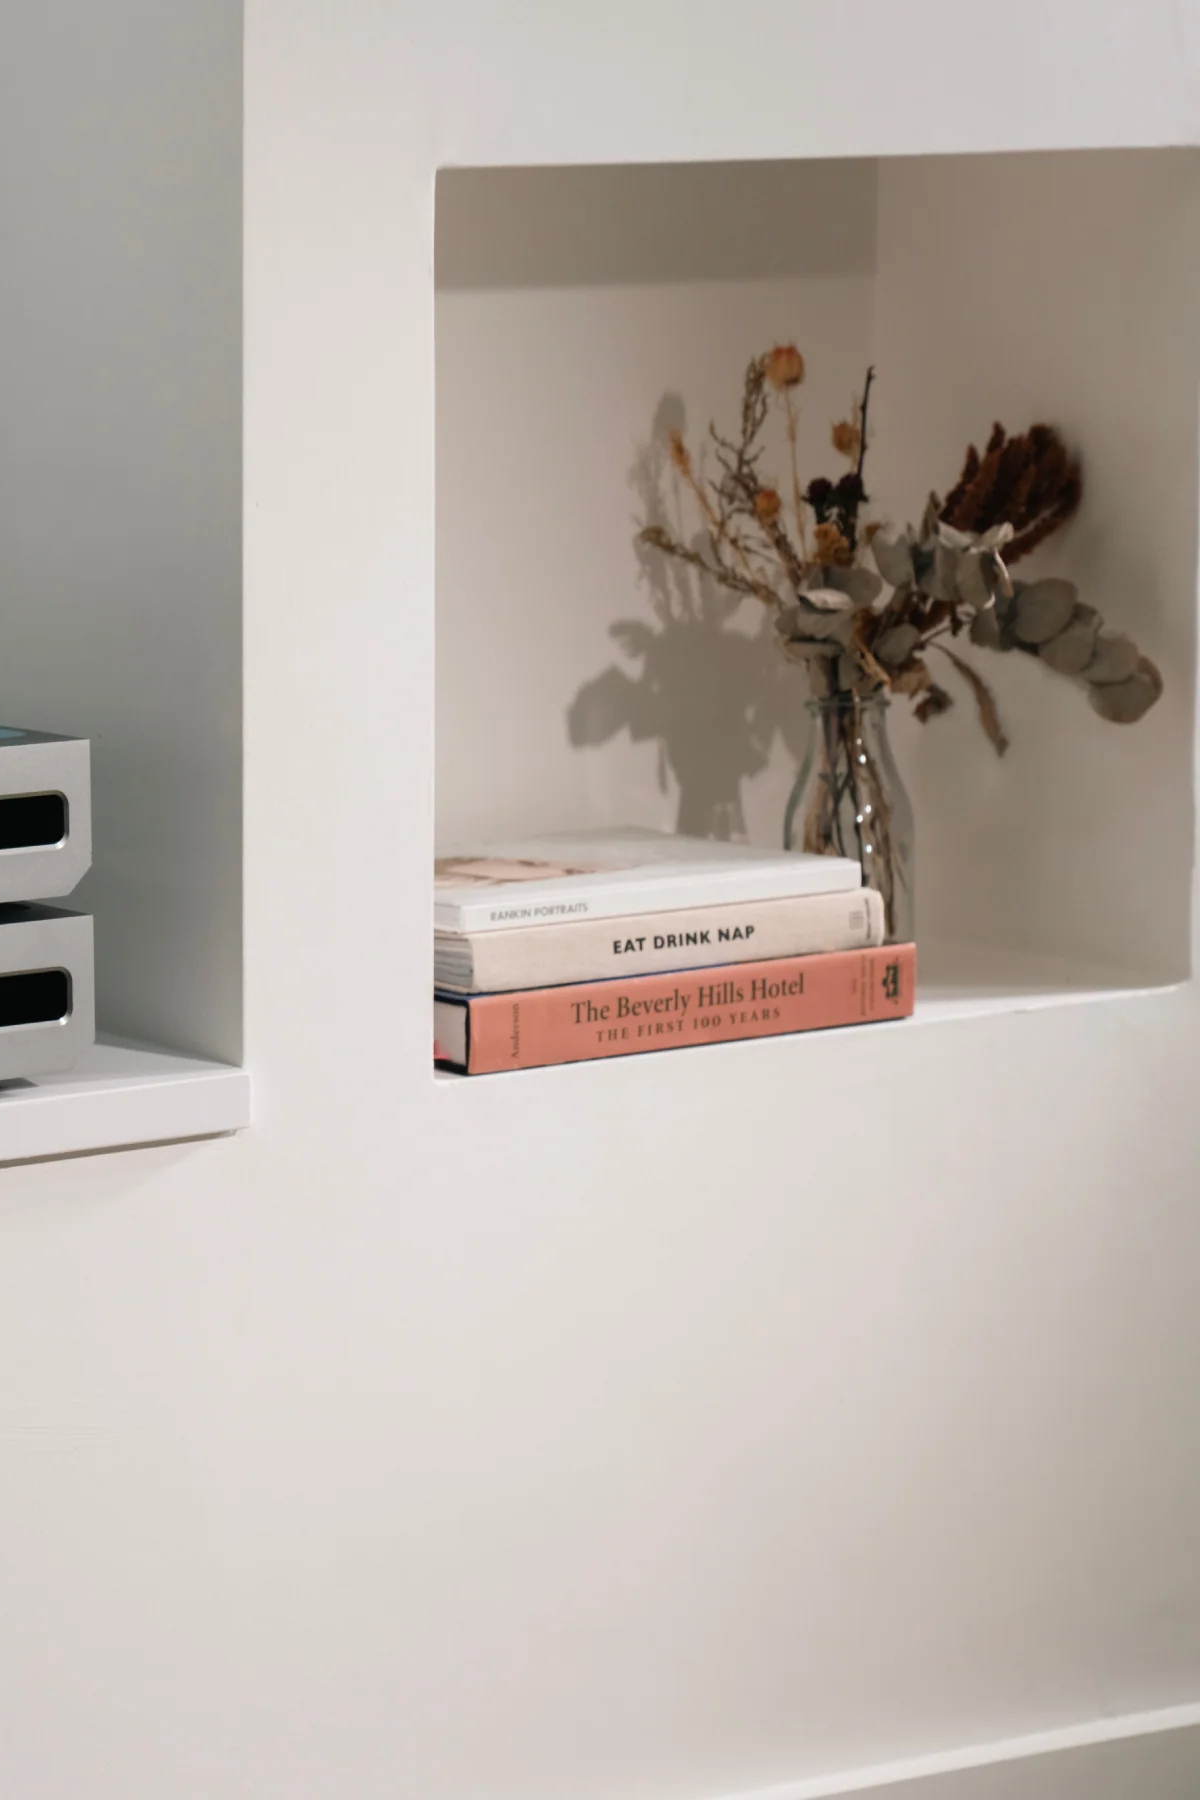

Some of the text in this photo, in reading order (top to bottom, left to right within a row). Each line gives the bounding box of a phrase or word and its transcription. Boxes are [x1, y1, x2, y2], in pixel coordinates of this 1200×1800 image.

[490, 903, 588, 922] RANKIN PORTRAITS
[613, 925, 756, 955] EAT DRINK NAP
[570, 972, 805, 1025] The Beverly Hills Hotel
[510, 1002, 520, 1059] Anderson
[596, 1007, 780, 1043] THE FIRST 100 YEARS
